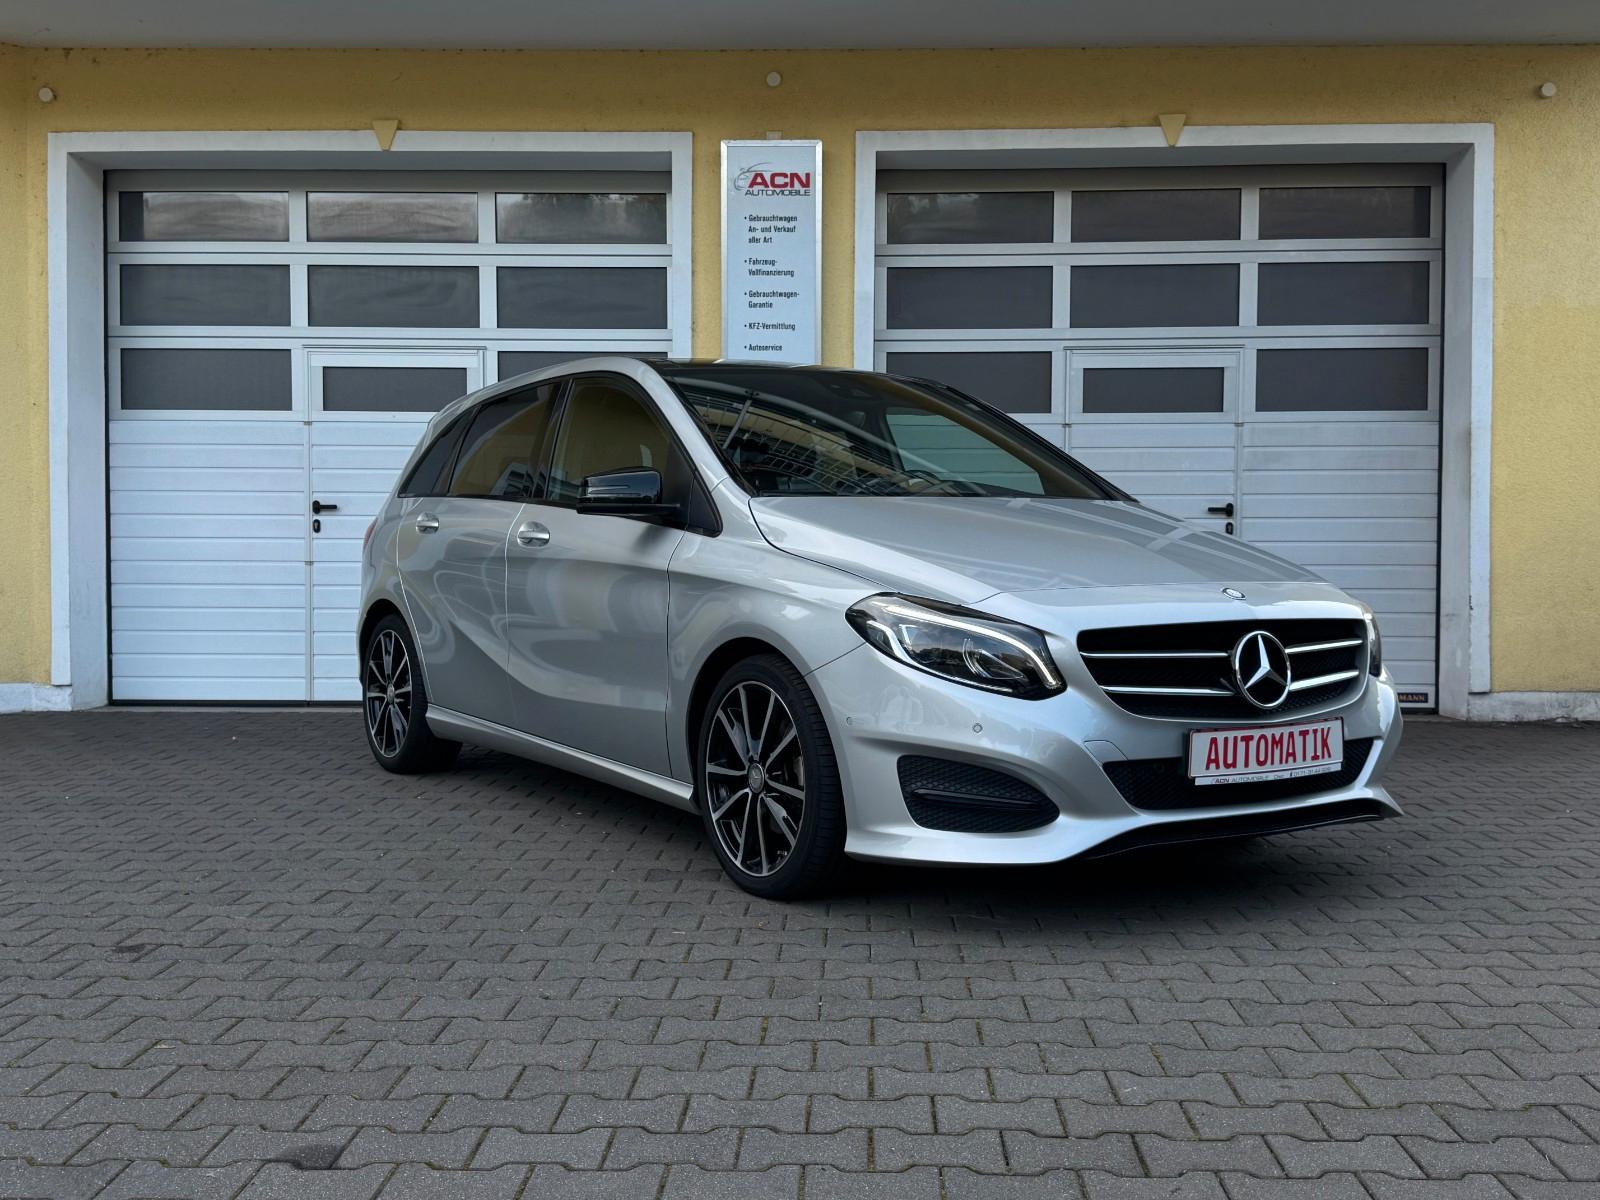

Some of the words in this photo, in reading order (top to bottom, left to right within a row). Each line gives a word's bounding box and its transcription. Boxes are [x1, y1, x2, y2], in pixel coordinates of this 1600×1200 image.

[748, 172, 811, 189] ACN
[745, 189, 811, 197] AUTOMOBILE
[748, 214, 798, 223] Gebrauchtwagen
[748, 257, 778, 266] Fahrzeug-
[748, 268, 795, 277] Vollfinanzierung
[748, 289, 800, 299] Gebrauchtwagen-
[748, 300, 773, 308] Garantie
[748, 322, 796, 331] KFZ-Vermittlung
[748, 343, 783, 351] Autoservice
[1205, 726, 1332, 770] AUTOMATIK
